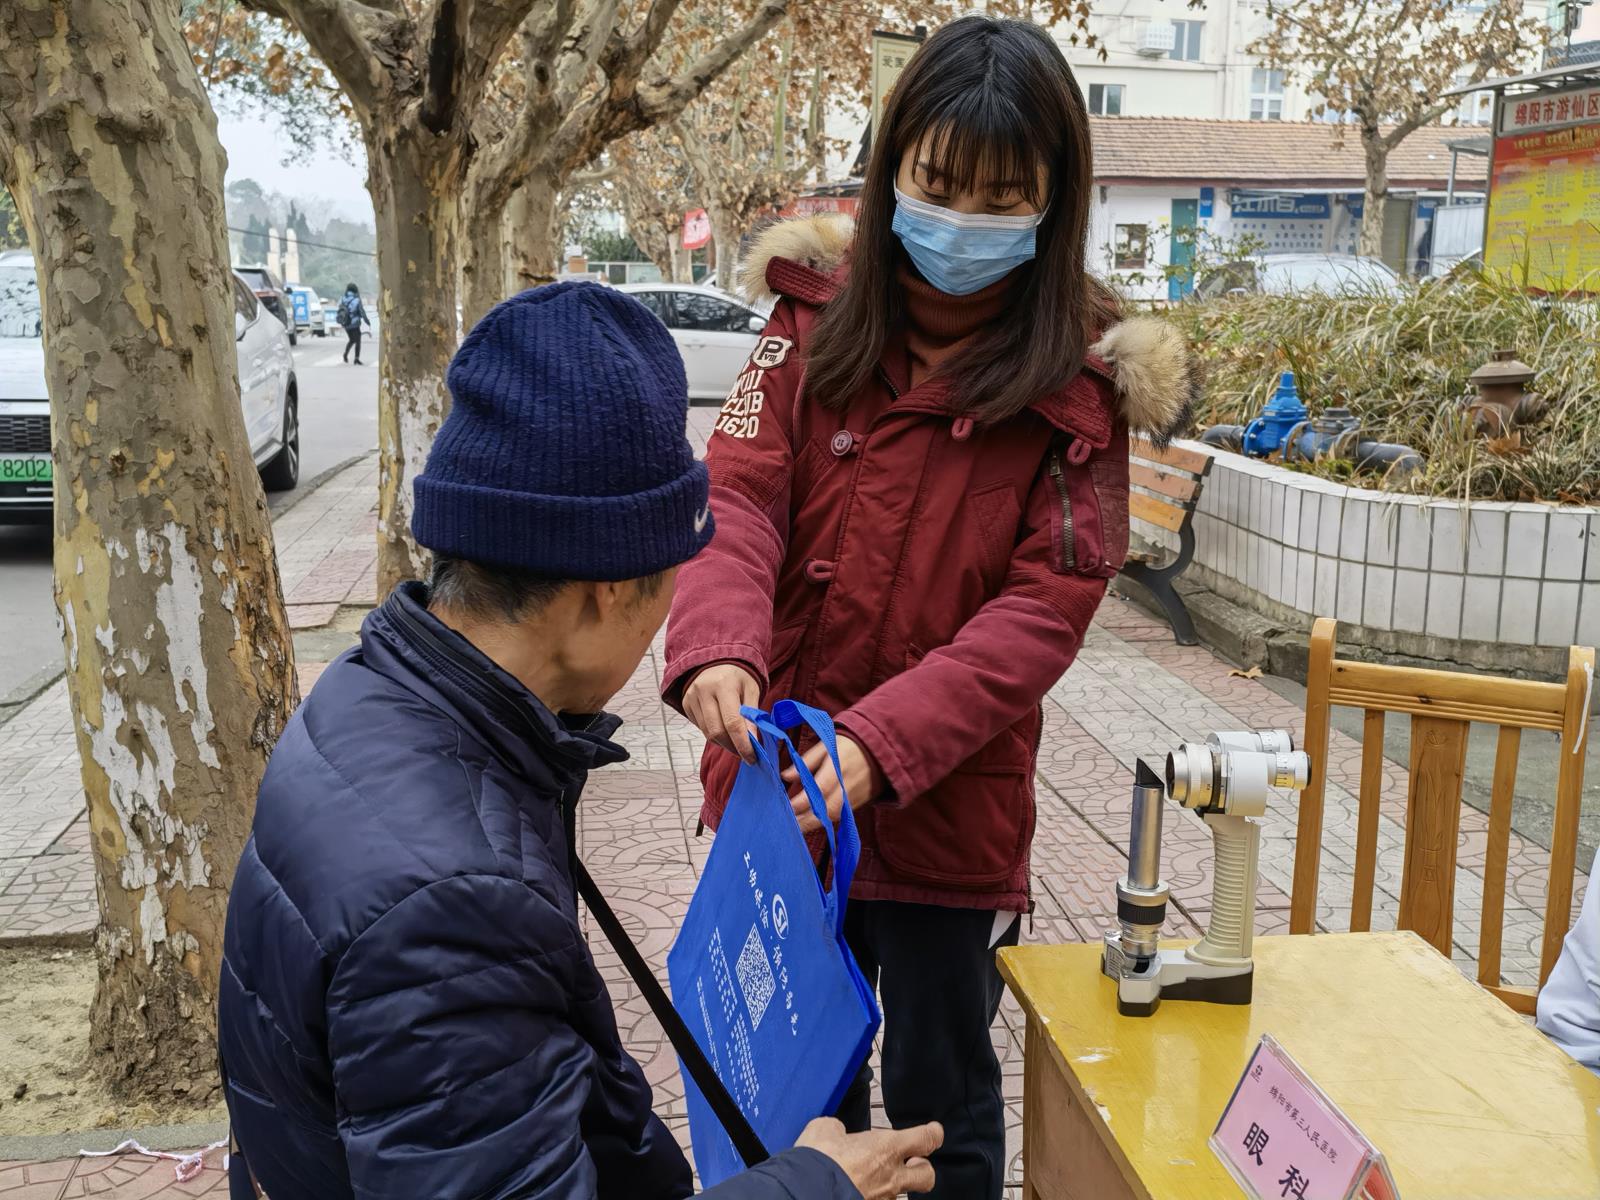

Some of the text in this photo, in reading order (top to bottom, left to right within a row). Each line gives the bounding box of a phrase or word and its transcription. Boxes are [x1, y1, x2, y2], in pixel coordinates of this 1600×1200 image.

[1514, 93, 1600, 126] 绵阳市游仙区
[720, 391, 765, 416] CLUB
[715, 416, 760, 438] 1620
[0, 459, 53, 478] 8202
[1268, 1085, 1338, 1164] 绵阳市第三人民医院
